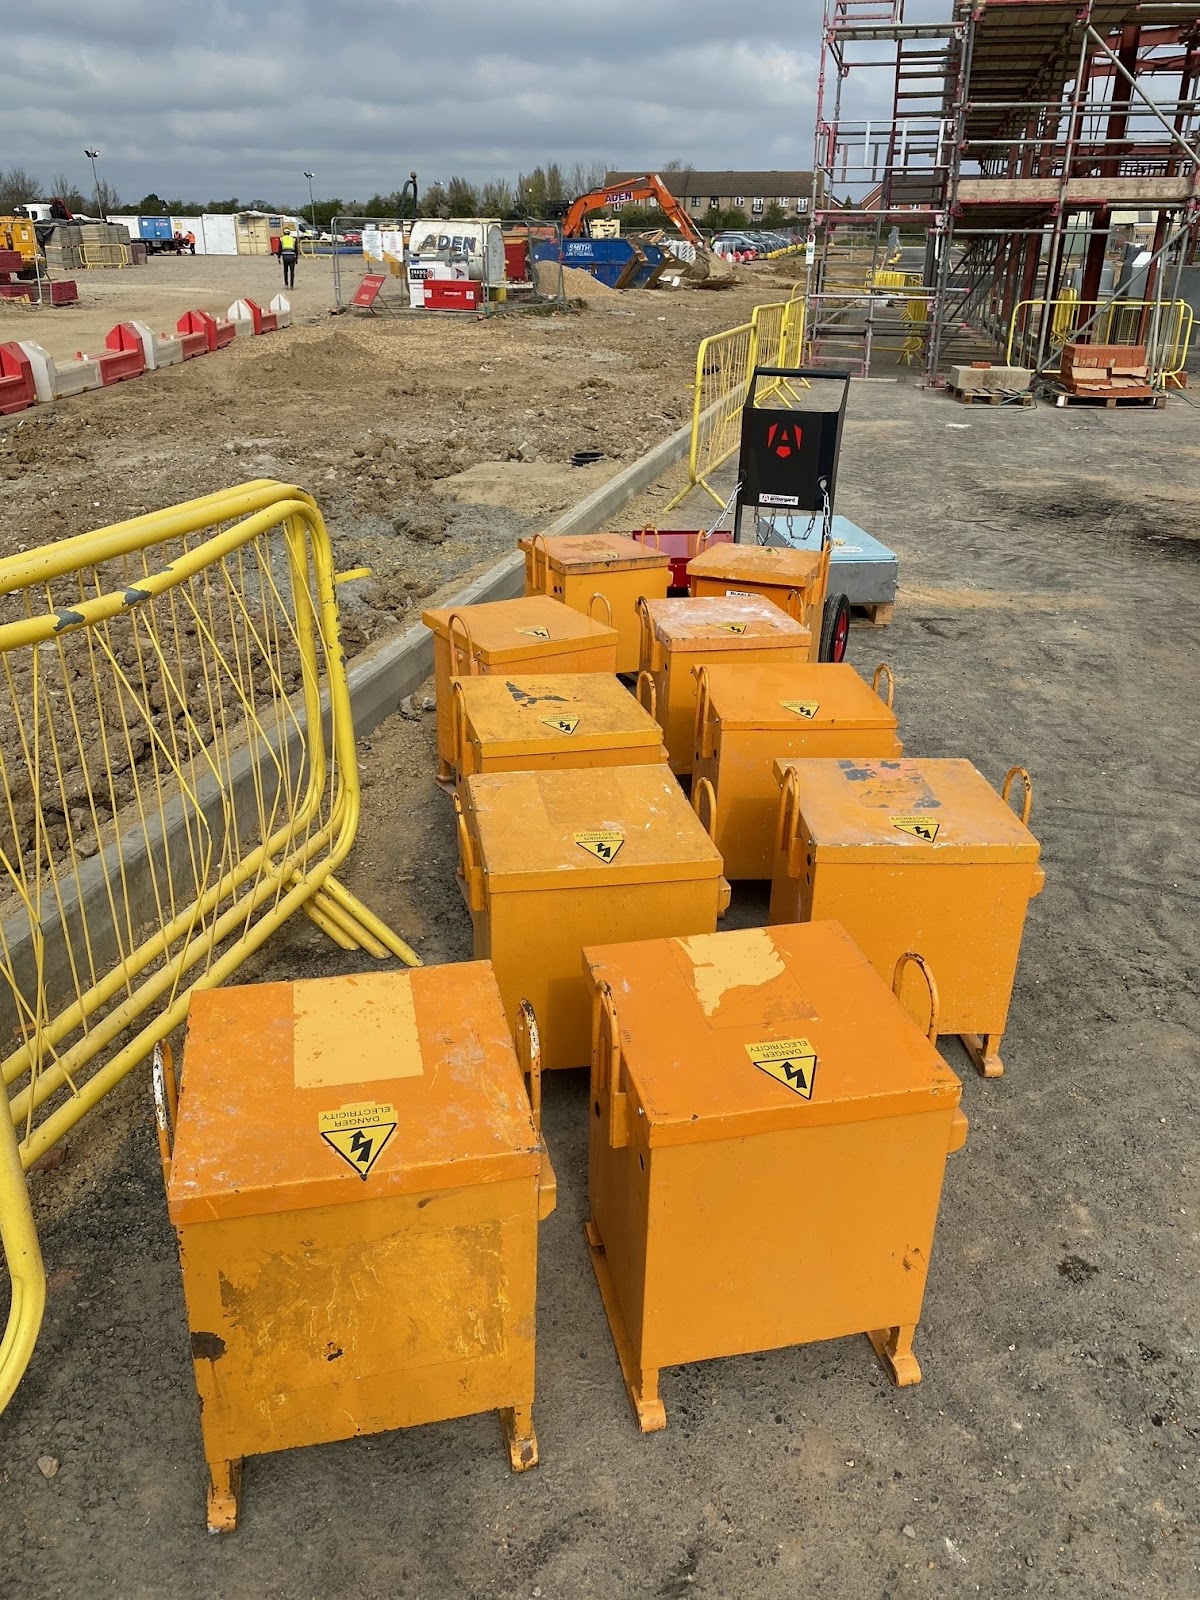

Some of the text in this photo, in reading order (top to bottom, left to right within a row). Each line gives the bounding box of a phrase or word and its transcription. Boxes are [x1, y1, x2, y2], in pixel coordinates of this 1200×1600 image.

[605, 192, 633, 204] ADEN
[421, 234, 477, 253] ADEN
[568, 244, 591, 252] SMITH
[750, 1040, 808, 1052] ELECTRICITY
[763, 1048, 802, 1058] DANGER
[322, 1106, 391, 1120] ELECTRICITY
[334, 1115, 380, 1127] DANGER
